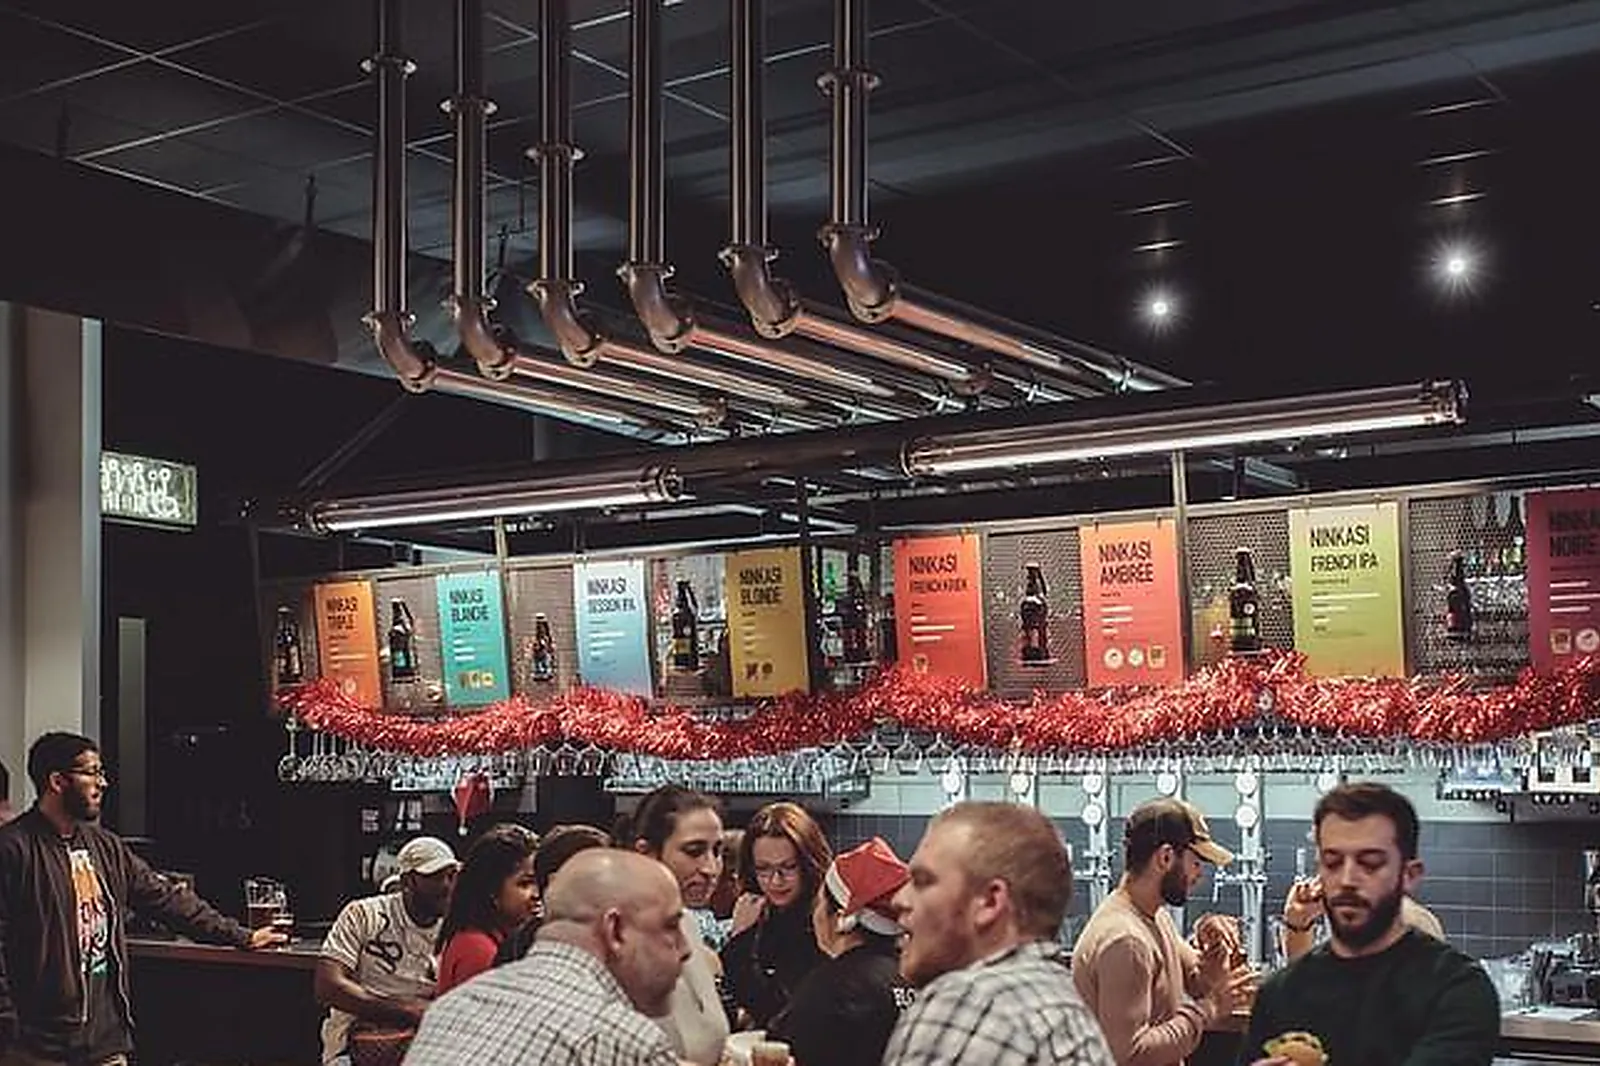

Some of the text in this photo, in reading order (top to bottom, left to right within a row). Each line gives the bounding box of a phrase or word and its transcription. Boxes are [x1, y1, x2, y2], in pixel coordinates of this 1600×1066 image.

[1310, 524, 1370, 548] NINKASI
[1099, 540, 1152, 564] NINKASI
[1311, 552, 1379, 572] FRENCH IPA
[909, 553, 957, 576] NINKASI
[739, 567, 782, 585] NINKASI
[740, 587, 785, 606] BLONDE
